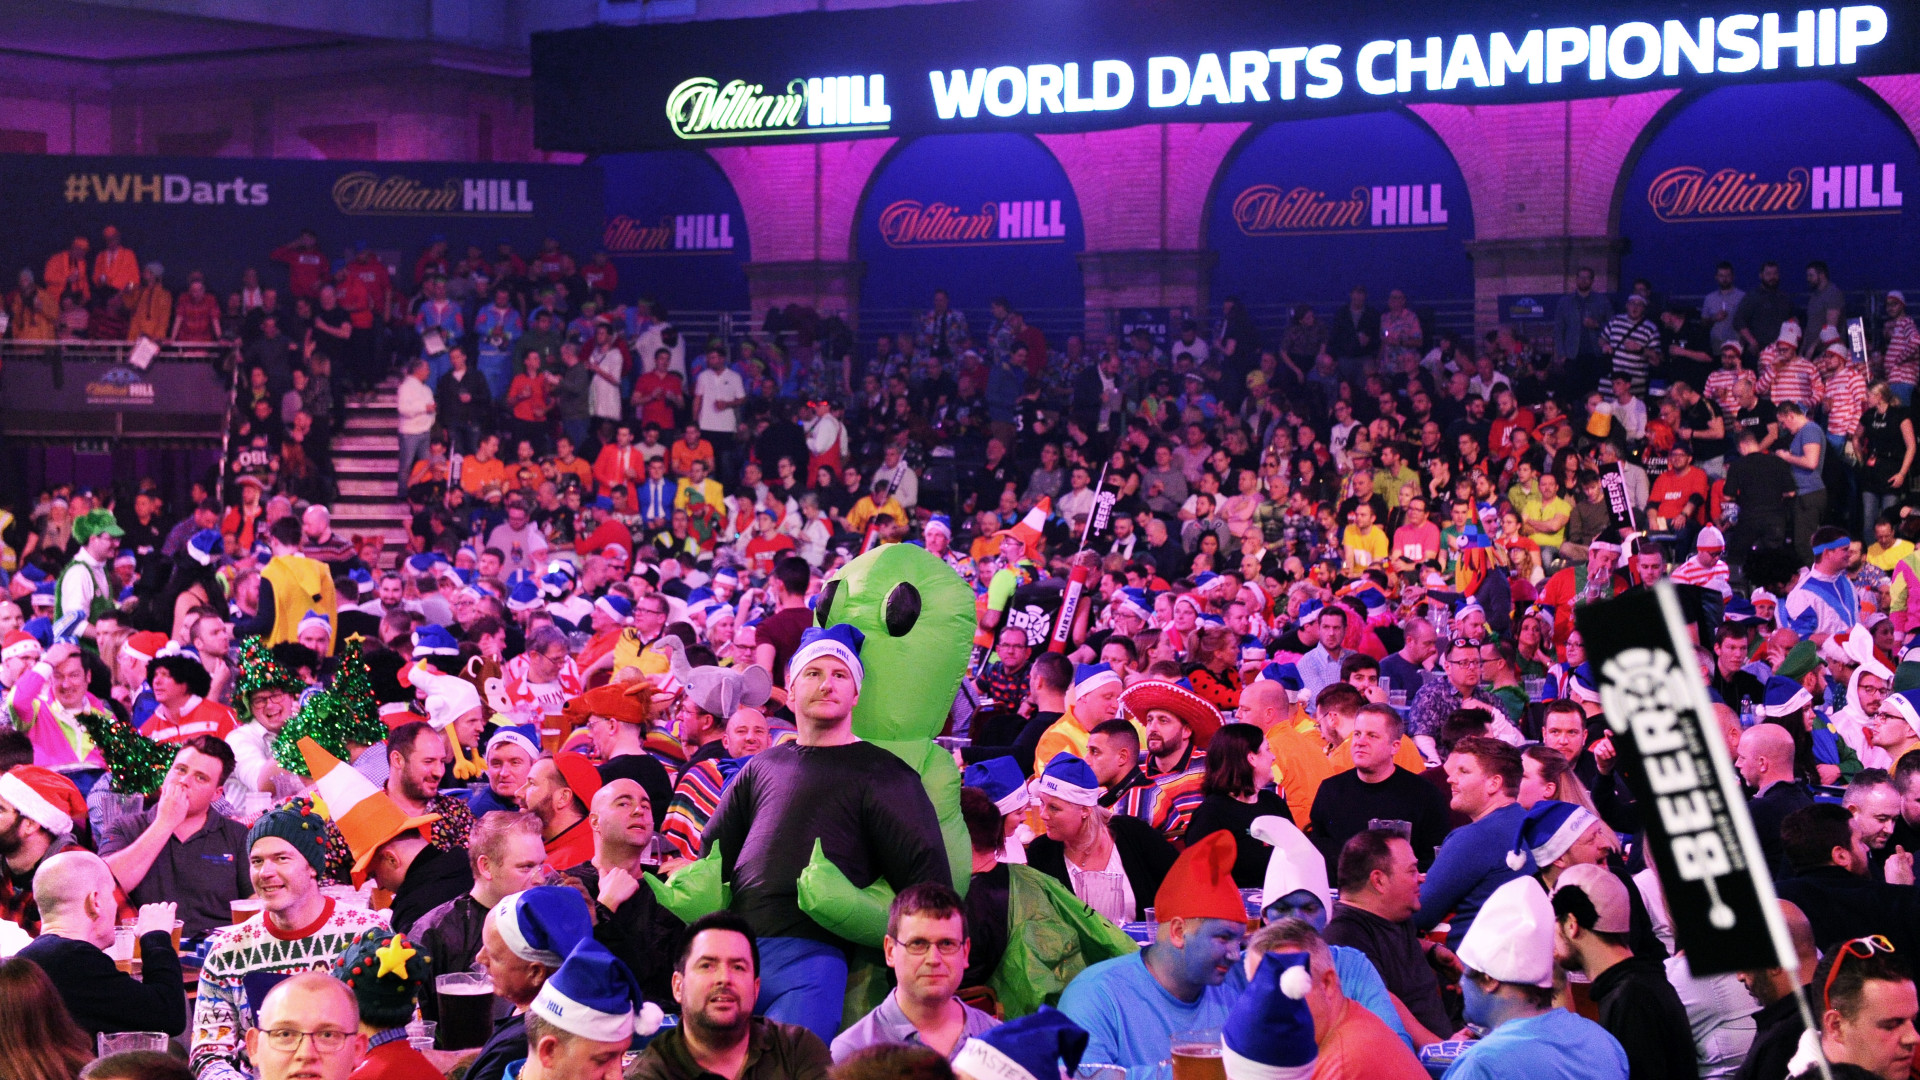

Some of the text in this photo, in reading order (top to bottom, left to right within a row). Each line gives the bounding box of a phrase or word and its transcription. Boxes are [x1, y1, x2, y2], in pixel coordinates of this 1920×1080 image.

[666, 4, 1888, 139] William HILL WORLD DARTS CHAMPIONSHIP
[64, 174, 269, 206] #WHDarts
[331, 171, 534, 217] William HILL
[1648, 163, 1902, 223] William HILL
[879, 199, 1066, 249] William HILL
[1232, 183, 1448, 237] William HILL
[675, 213, 734, 250] HILL
[1093, 501, 1111, 530] BEER
[1608, 482, 1625, 514] BEER
[836, 647, 850, 661] HILL
[1046, 781, 1058, 792] HILL
[1631, 708, 1732, 882] BEER
[546, 1000, 564, 1017] HILL
